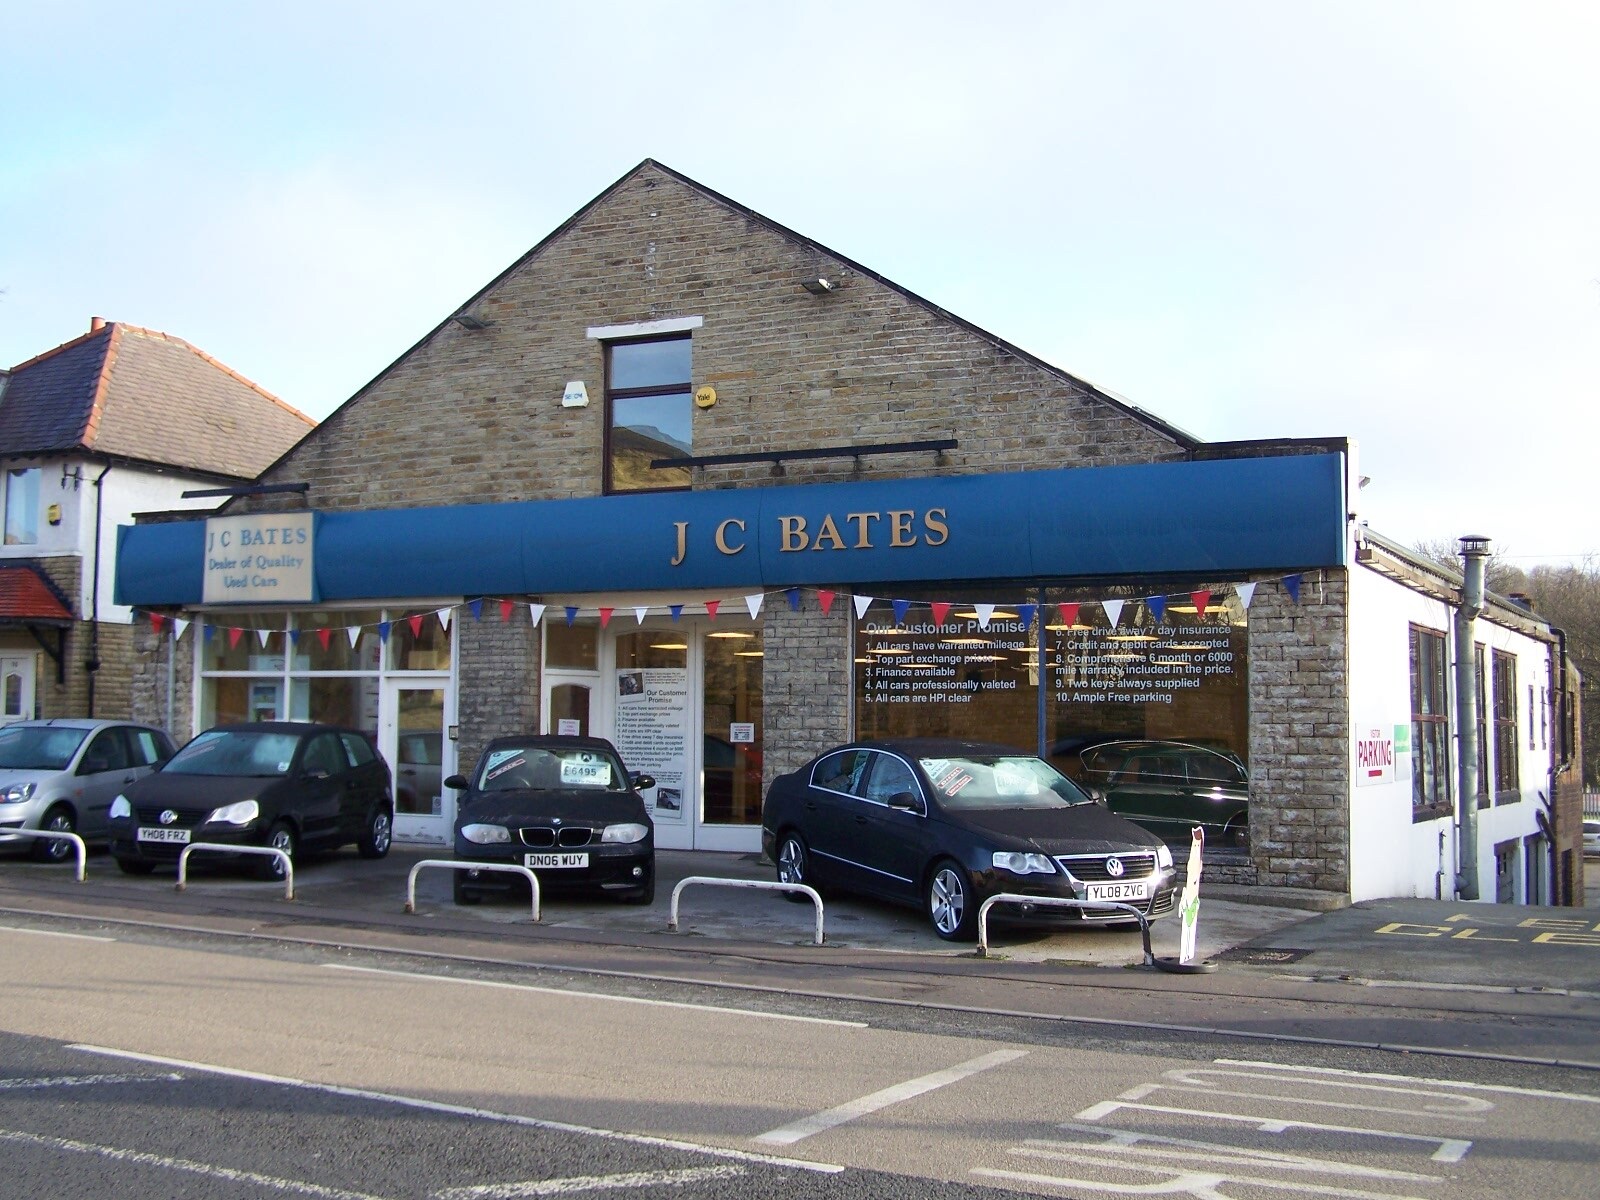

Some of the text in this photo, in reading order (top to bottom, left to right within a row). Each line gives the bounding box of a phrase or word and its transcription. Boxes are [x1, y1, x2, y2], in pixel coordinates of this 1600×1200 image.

[208, 528, 306, 552] J C BATES
[671, 508, 949, 566] J C BATES
[209, 555, 304, 570] Dealer of Quality
[224, 575, 278, 588] Used Cars
[866, 620, 1026, 635] Our Customer Promise
[1092, 627, 1117, 636] drive
[1149, 626, 1154, 635] 7
[1158, 625, 1176, 637] day
[1179, 625, 1231, 635] insurance
[876, 642, 888, 650] All
[913, 641, 935, 650] have
[937, 641, 984, 650] warranted
[987, 640, 1025, 650] mileage
[1056, 638, 1229, 650] 7. Credit and debit cards accepted
[876, 655, 894, 665] Top
[896, 655, 914, 665] part
[917, 654, 962, 664] exchange
[1056, 655, 1064, 663] 8.
[1149, 654, 1155, 662] 6
[1158, 653, 1191, 662] month
[1208, 652, 1233, 662] 6000
[865, 667, 956, 676] 3. Finance available
[1056, 665, 1077, 674] mile
[1126, 665, 1170, 674] included
[1173, 665, 1182, 674] in
[1185, 664, 1202, 674] the
[1204, 664, 1234, 675] price.
[865, 682, 873, 690] 4.
[876, 681, 888, 690] All
[912, 680, 978, 691] professionally
[981, 680, 1016, 689] valeted
[1056, 678, 1200, 690] 9. Two keys always supplied
[865, 694, 873, 702] 5.
[876, 694, 888, 702] All
[930, 694, 945, 702] HPI
[948, 694, 971, 702] clear
[1056, 692, 1172, 704] 10. Ample Free parking
[1359, 740, 1391, 767] PARKING
[142, 830, 186, 840] YH08 FRZ
[530, 855, 583, 866] DN06 WUY
[1093, 885, 1142, 898] YL08 ZVG
